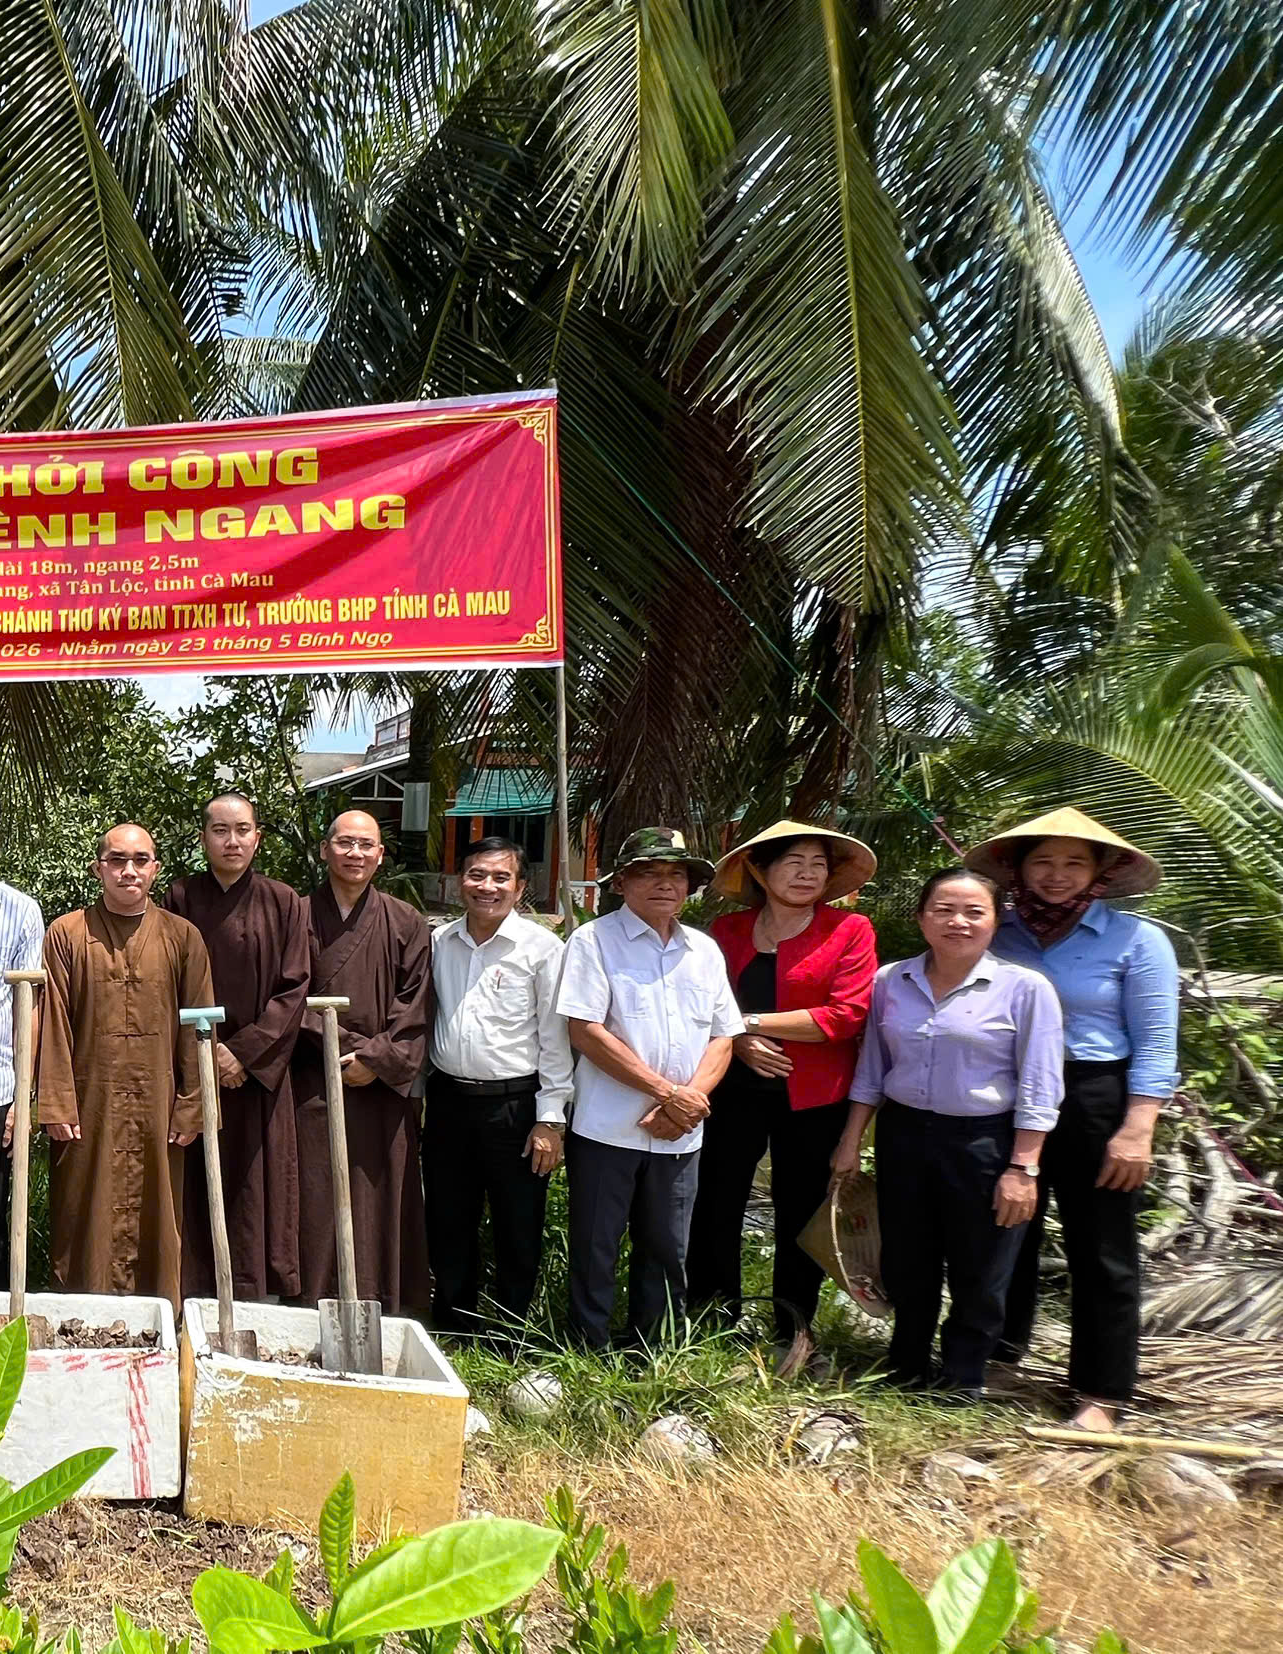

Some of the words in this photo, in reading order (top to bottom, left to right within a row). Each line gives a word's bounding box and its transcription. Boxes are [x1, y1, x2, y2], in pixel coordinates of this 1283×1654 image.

[128, 447, 319, 492] CÔNG
[144, 494, 406, 544] NGANG
[29, 560, 78, 576] 18m,
[83, 559, 145, 577] ngang
[148, 554, 200, 572] 2,5m
[38, 582, 61, 597] xã
[66, 580, 104, 596] Tân
[109, 579, 149, 597] Lộc,
[154, 575, 195, 592] tỉnh
[200, 573, 225, 589] Cà
[230, 571, 275, 588] Mau
[57, 605, 94, 633] THƠ
[98, 602, 123, 631] KÝ
[127, 604, 167, 631] BAN
[171, 602, 218, 630] TTXH
[222, 600, 252, 629] TƯ,
[255, 592, 333, 627] TRƯỞNG
[337, 596, 377, 623] BHP
[382, 587, 428, 620] TỈNH
[433, 588, 460, 618] CÀ
[465, 589, 511, 617] MAU
[58, 638, 117, 656] Nhằm
[122, 638, 174, 656] ngày
[178, 637, 207, 652] 23
[212, 634, 273, 653] tháng
[277, 633, 292, 648] 5
[297, 631, 345, 648] Bính
[350, 631, 394, 648] Ngọ
